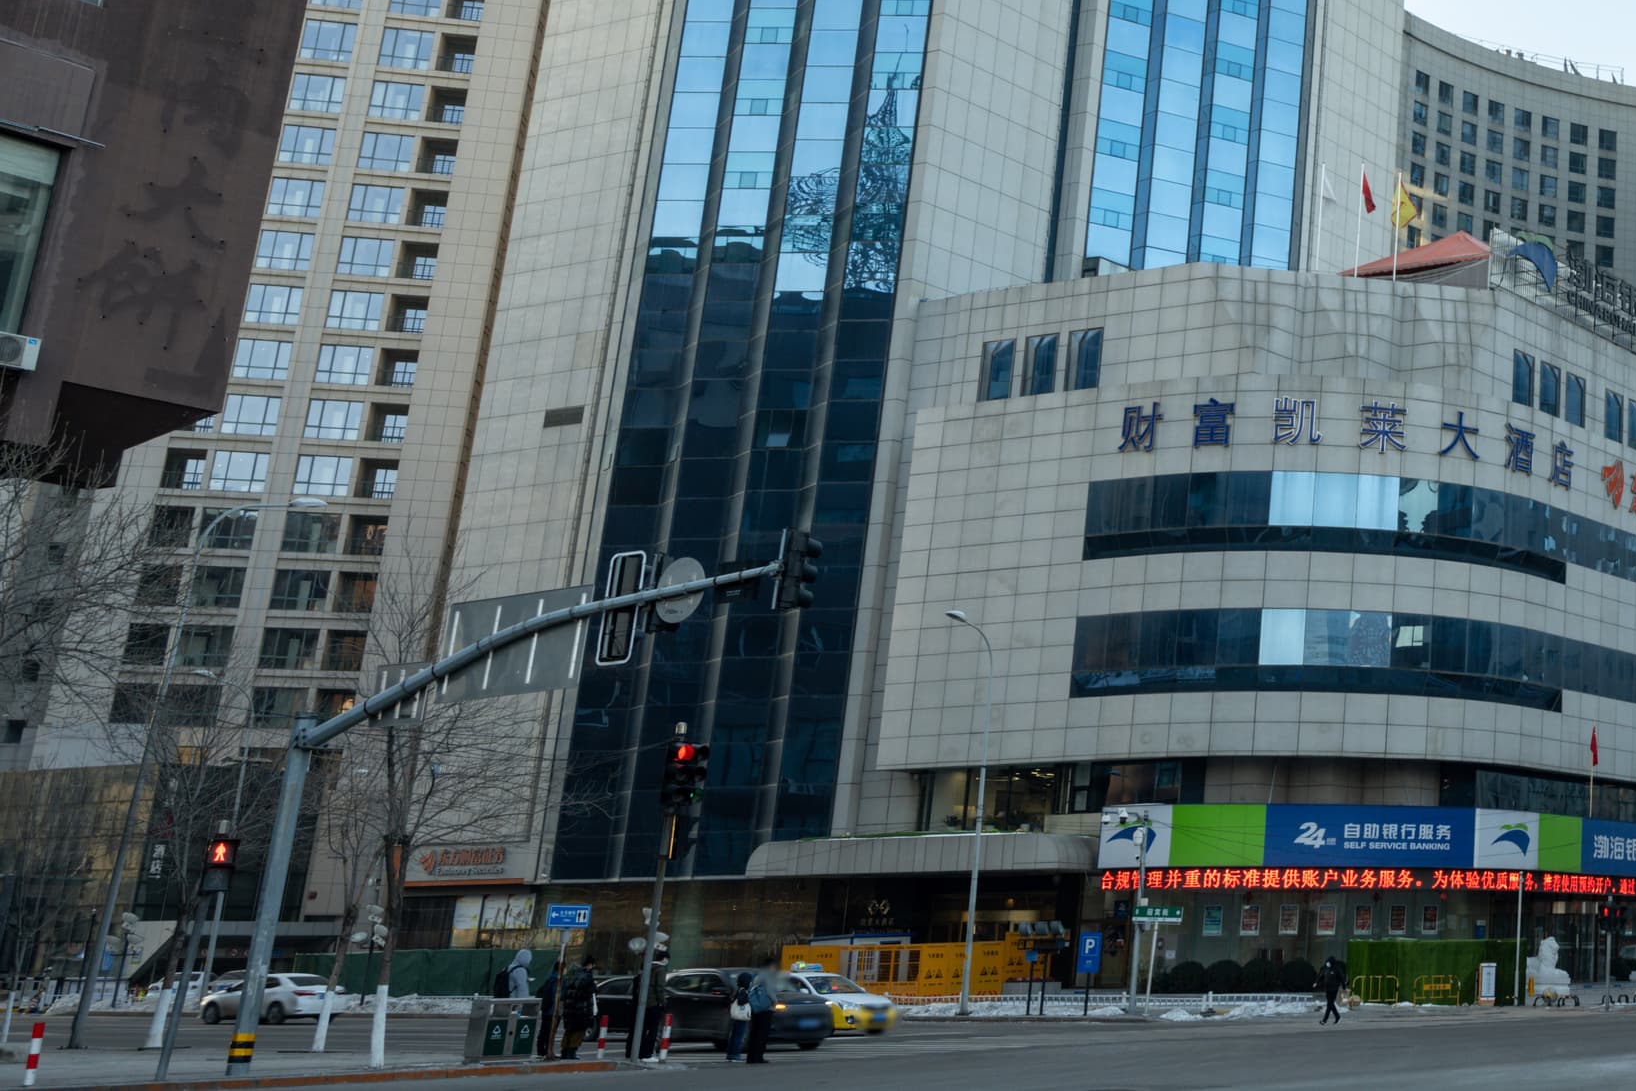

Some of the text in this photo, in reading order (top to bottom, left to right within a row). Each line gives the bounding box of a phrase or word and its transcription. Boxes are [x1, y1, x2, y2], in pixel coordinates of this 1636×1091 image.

[1118, 396, 1574, 490] 财富凯莱大酒店
[1344, 823, 1451, 841] 自助银行服务
[1344, 842, 1450, 851] SELF SERVICE BANKING
